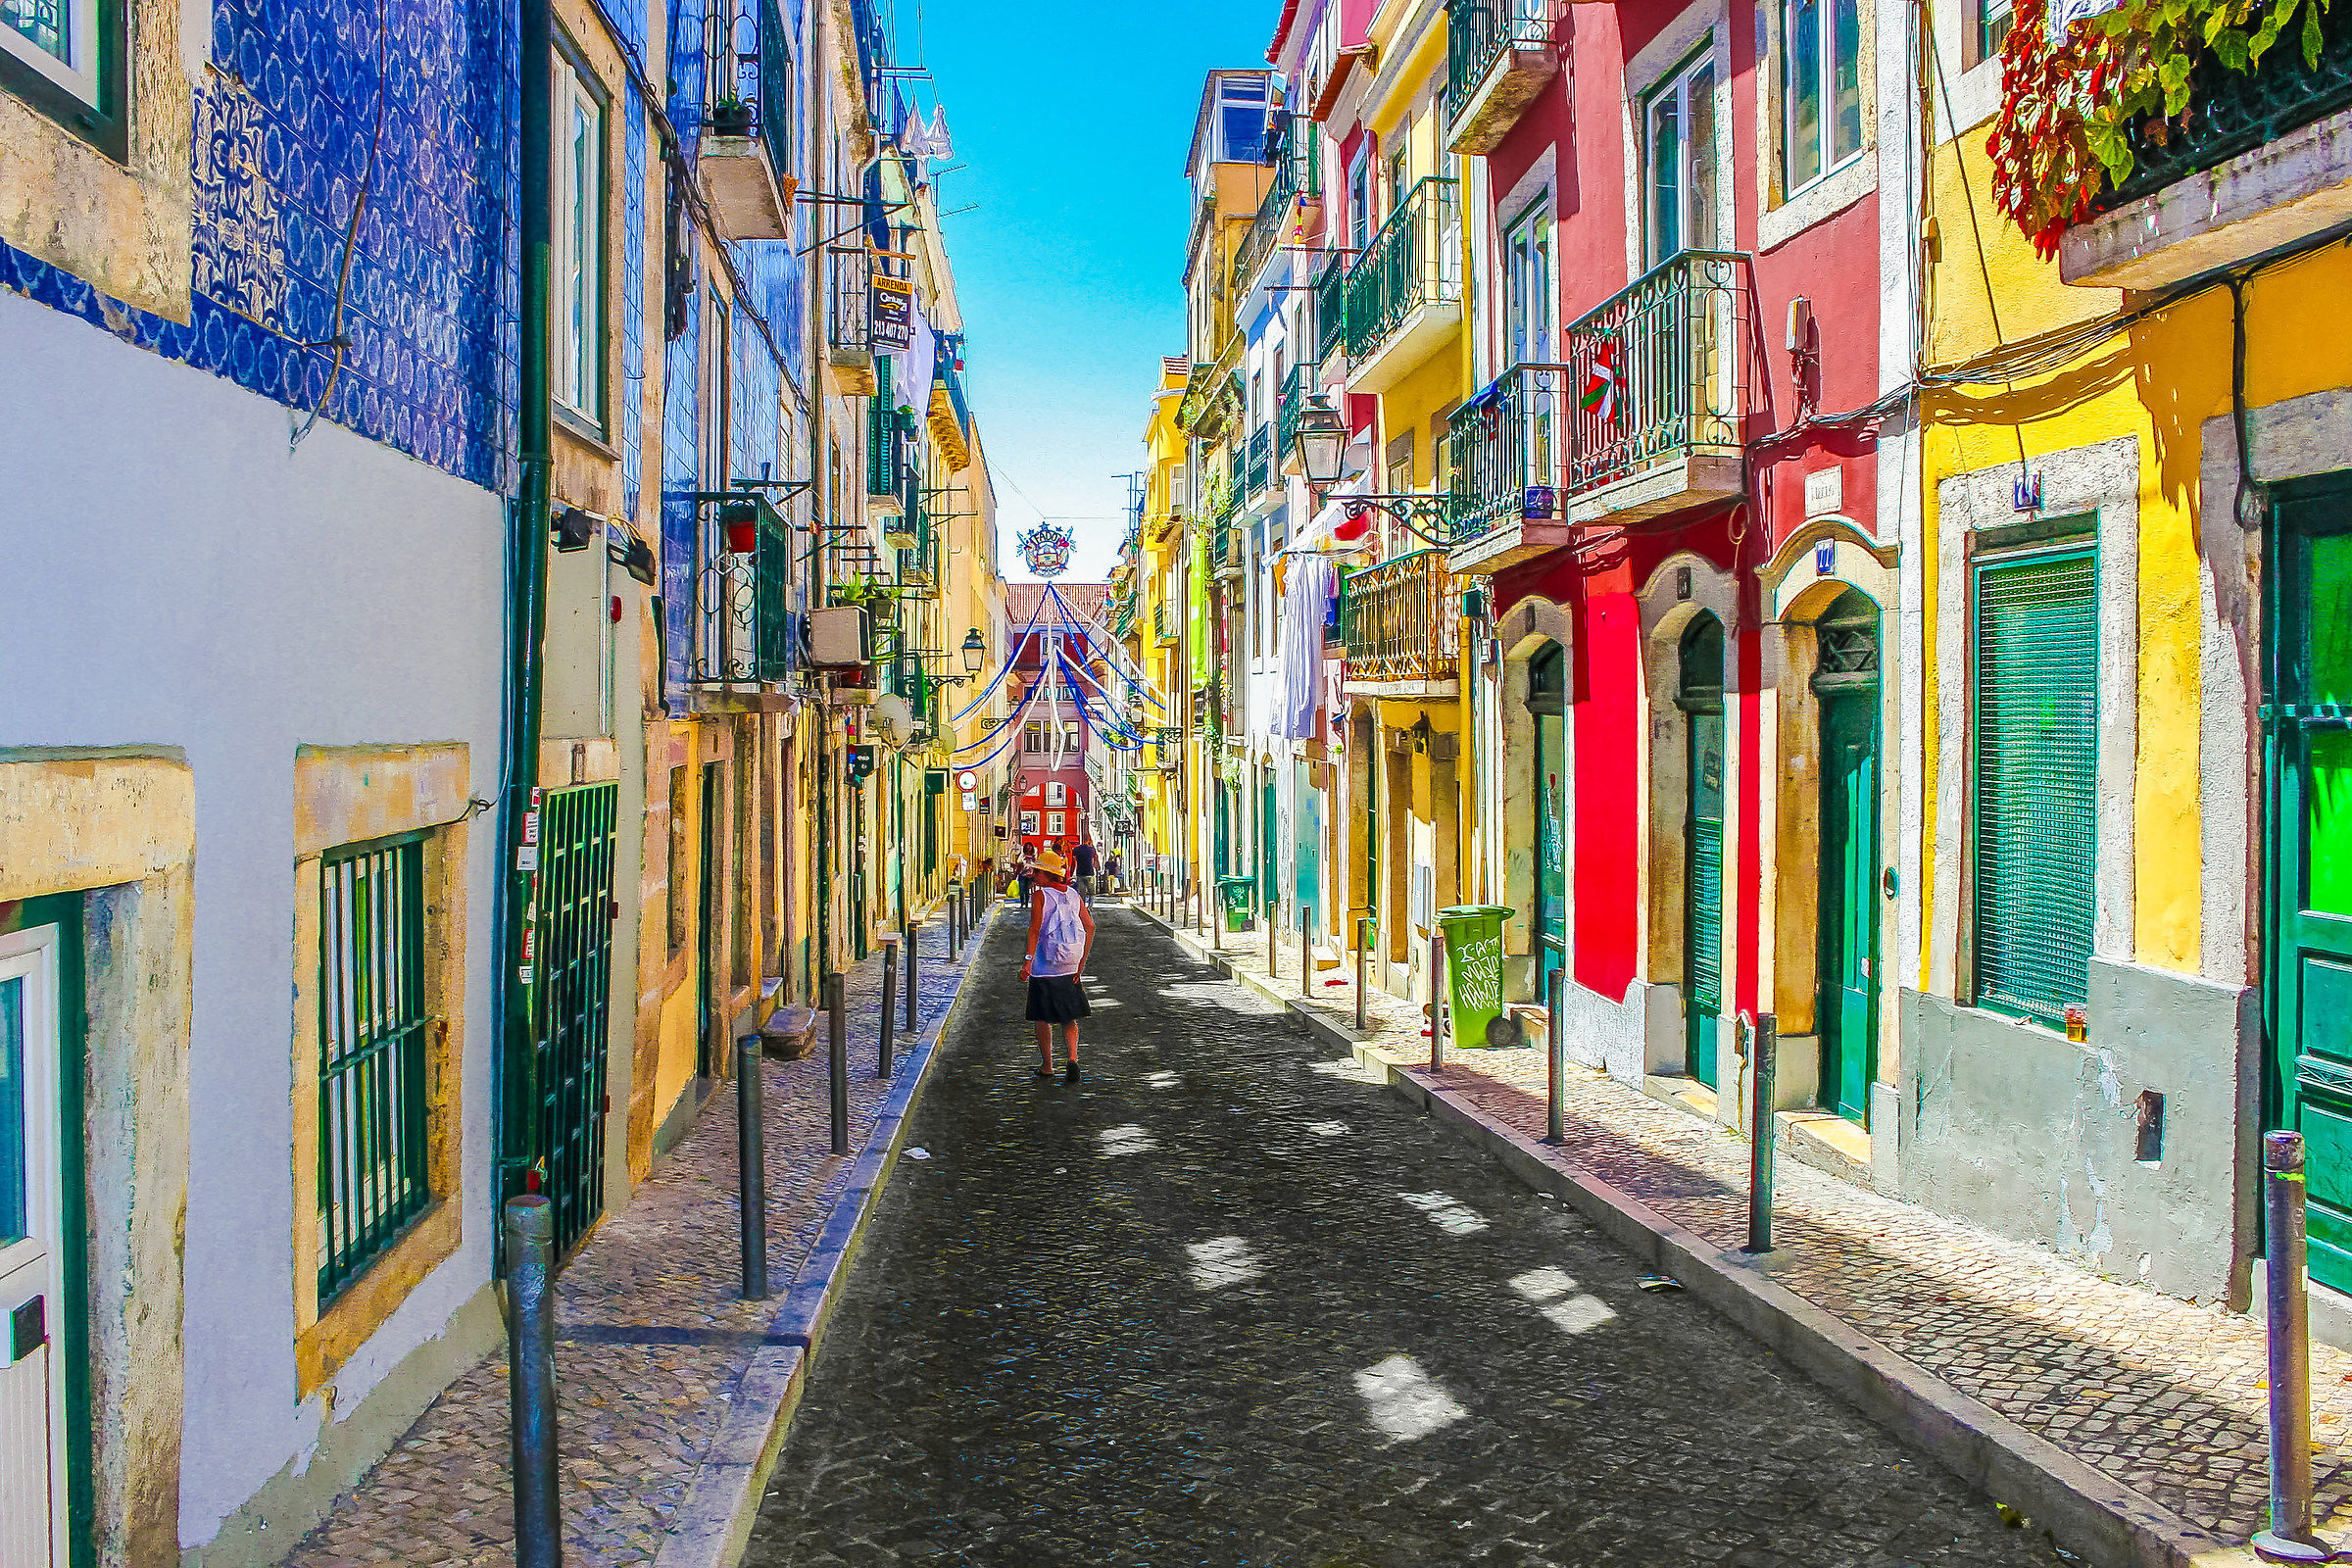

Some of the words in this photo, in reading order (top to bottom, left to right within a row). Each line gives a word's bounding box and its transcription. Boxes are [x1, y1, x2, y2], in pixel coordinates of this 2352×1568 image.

[877, 277, 908, 292] ARRENDA
[874, 319, 885, 336] 213
[886, 322, 897, 339] 407
[897, 324, 908, 341] 270
[1034, 531, 1058, 544] FADO
[1818, 543, 1831, 568] 11
